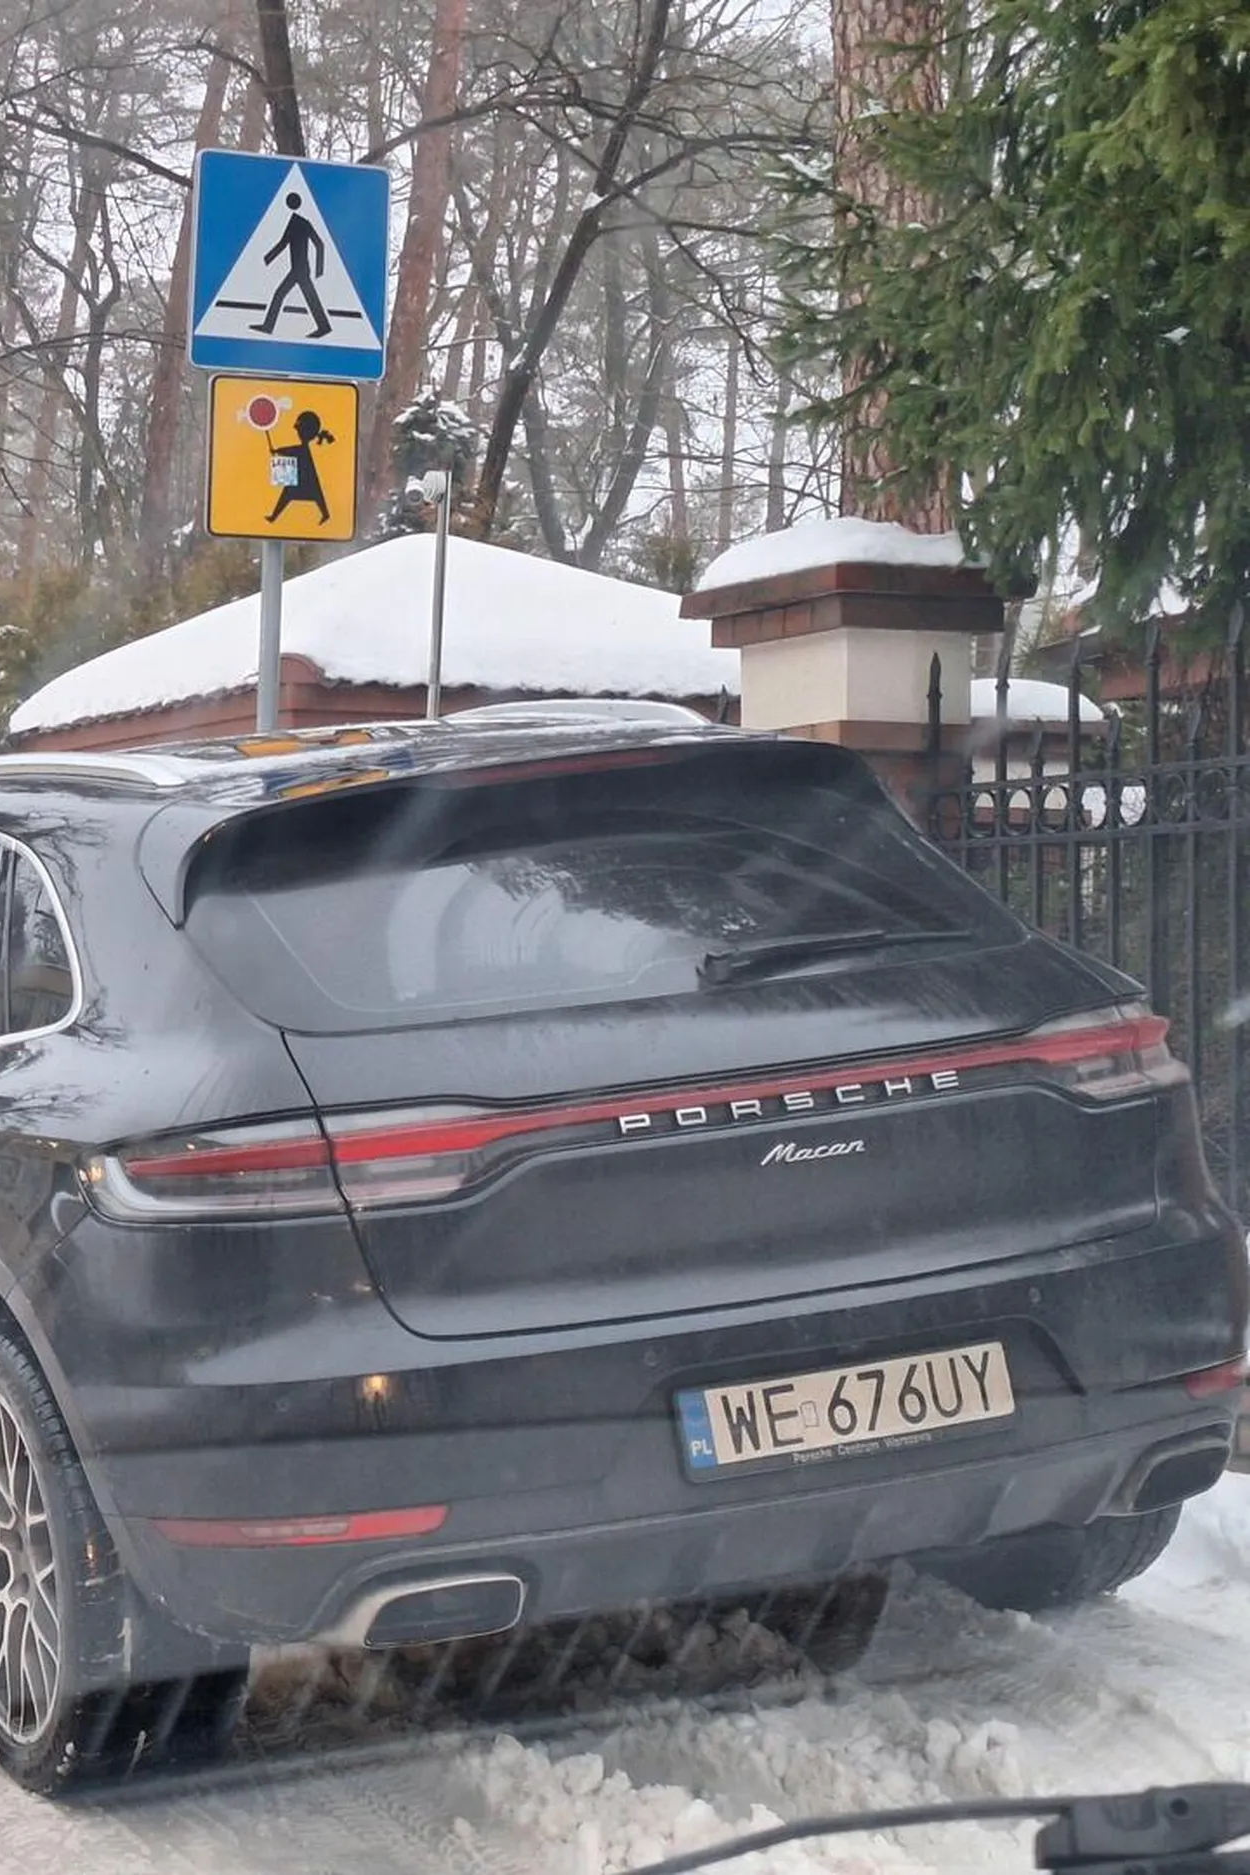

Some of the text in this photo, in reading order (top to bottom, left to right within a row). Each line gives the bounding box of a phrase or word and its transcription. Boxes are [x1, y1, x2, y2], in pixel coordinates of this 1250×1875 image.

[619, 1070, 960, 1134] PORSCHE
[760, 1139, 866, 1166] Macan
[721, 1351, 991, 1455] WE 676UY
[691, 1439, 713, 1456] PL
